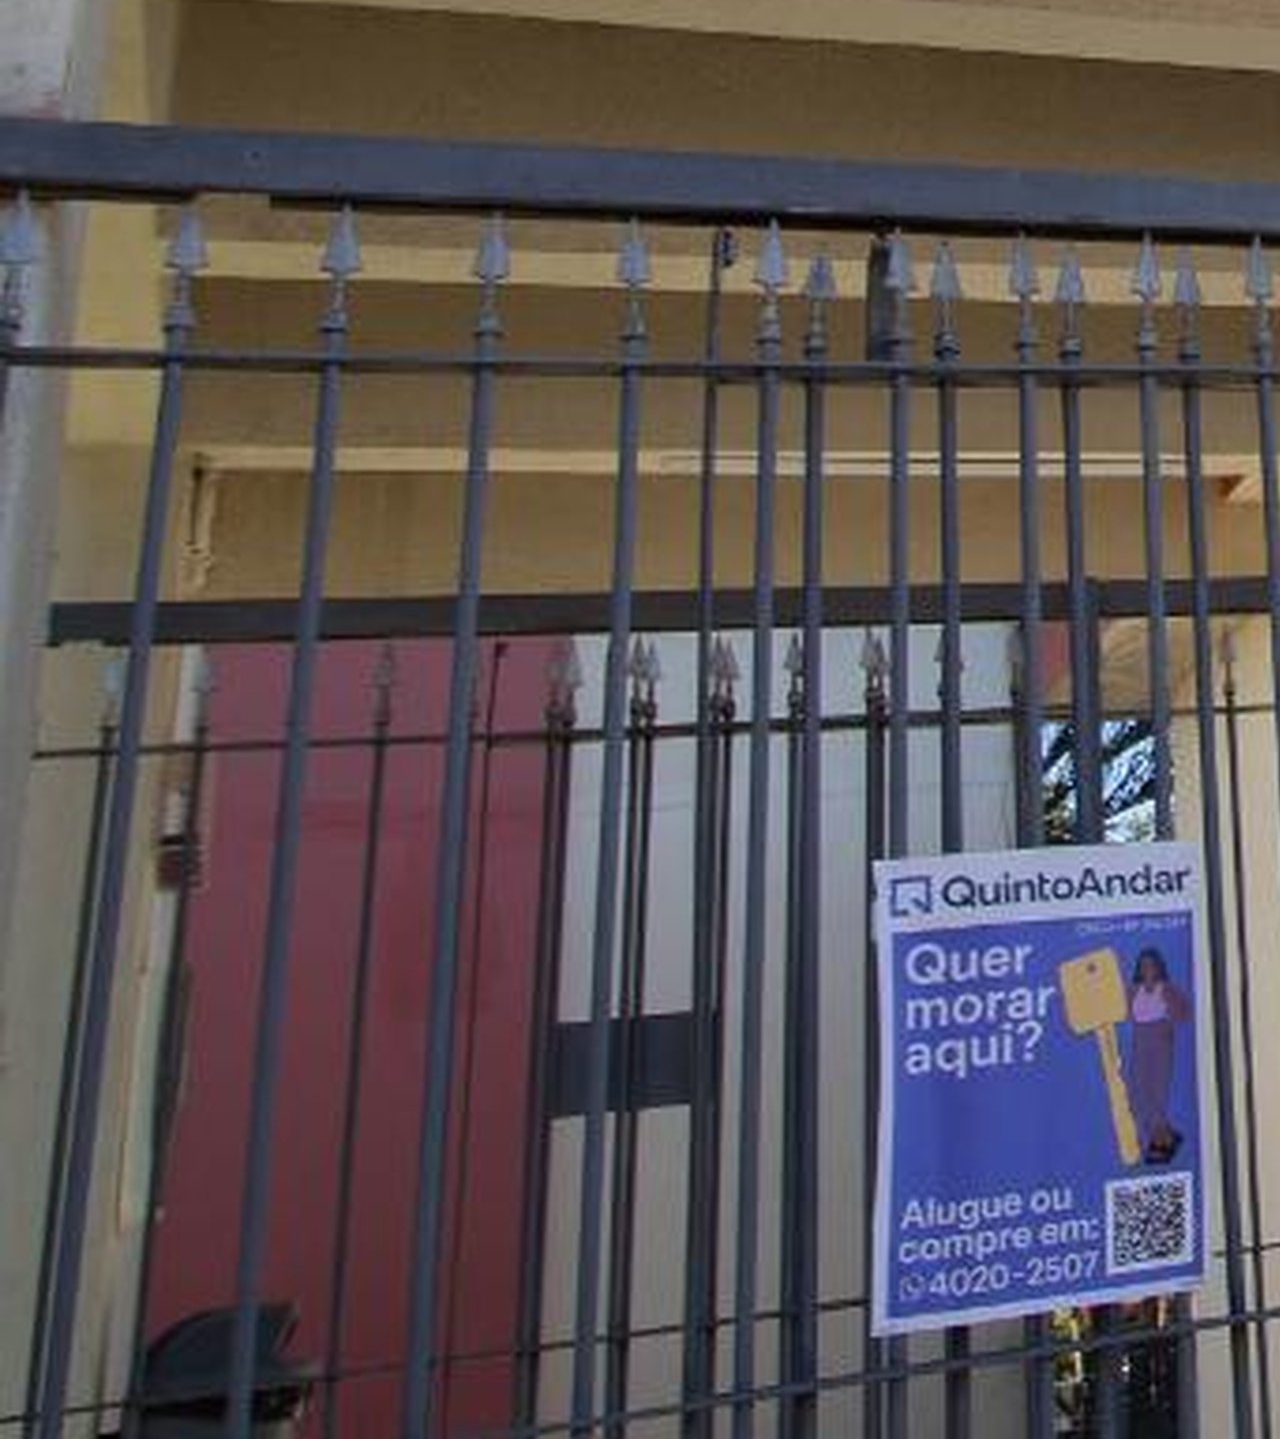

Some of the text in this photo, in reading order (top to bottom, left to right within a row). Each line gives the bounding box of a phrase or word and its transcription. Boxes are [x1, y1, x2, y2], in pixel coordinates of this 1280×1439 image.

[941, 863, 1192, 909] QuintoAndar
[906, 943, 1033, 985] Quer
[906, 986, 1056, 1030] morar
[906, 1022, 1044, 1078] aqui?
[900, 1187, 1073, 1231] Alugue ou
[899, 1217, 1100, 1263] compre em:
[928, 1249, 1101, 1297] 4020-2507
